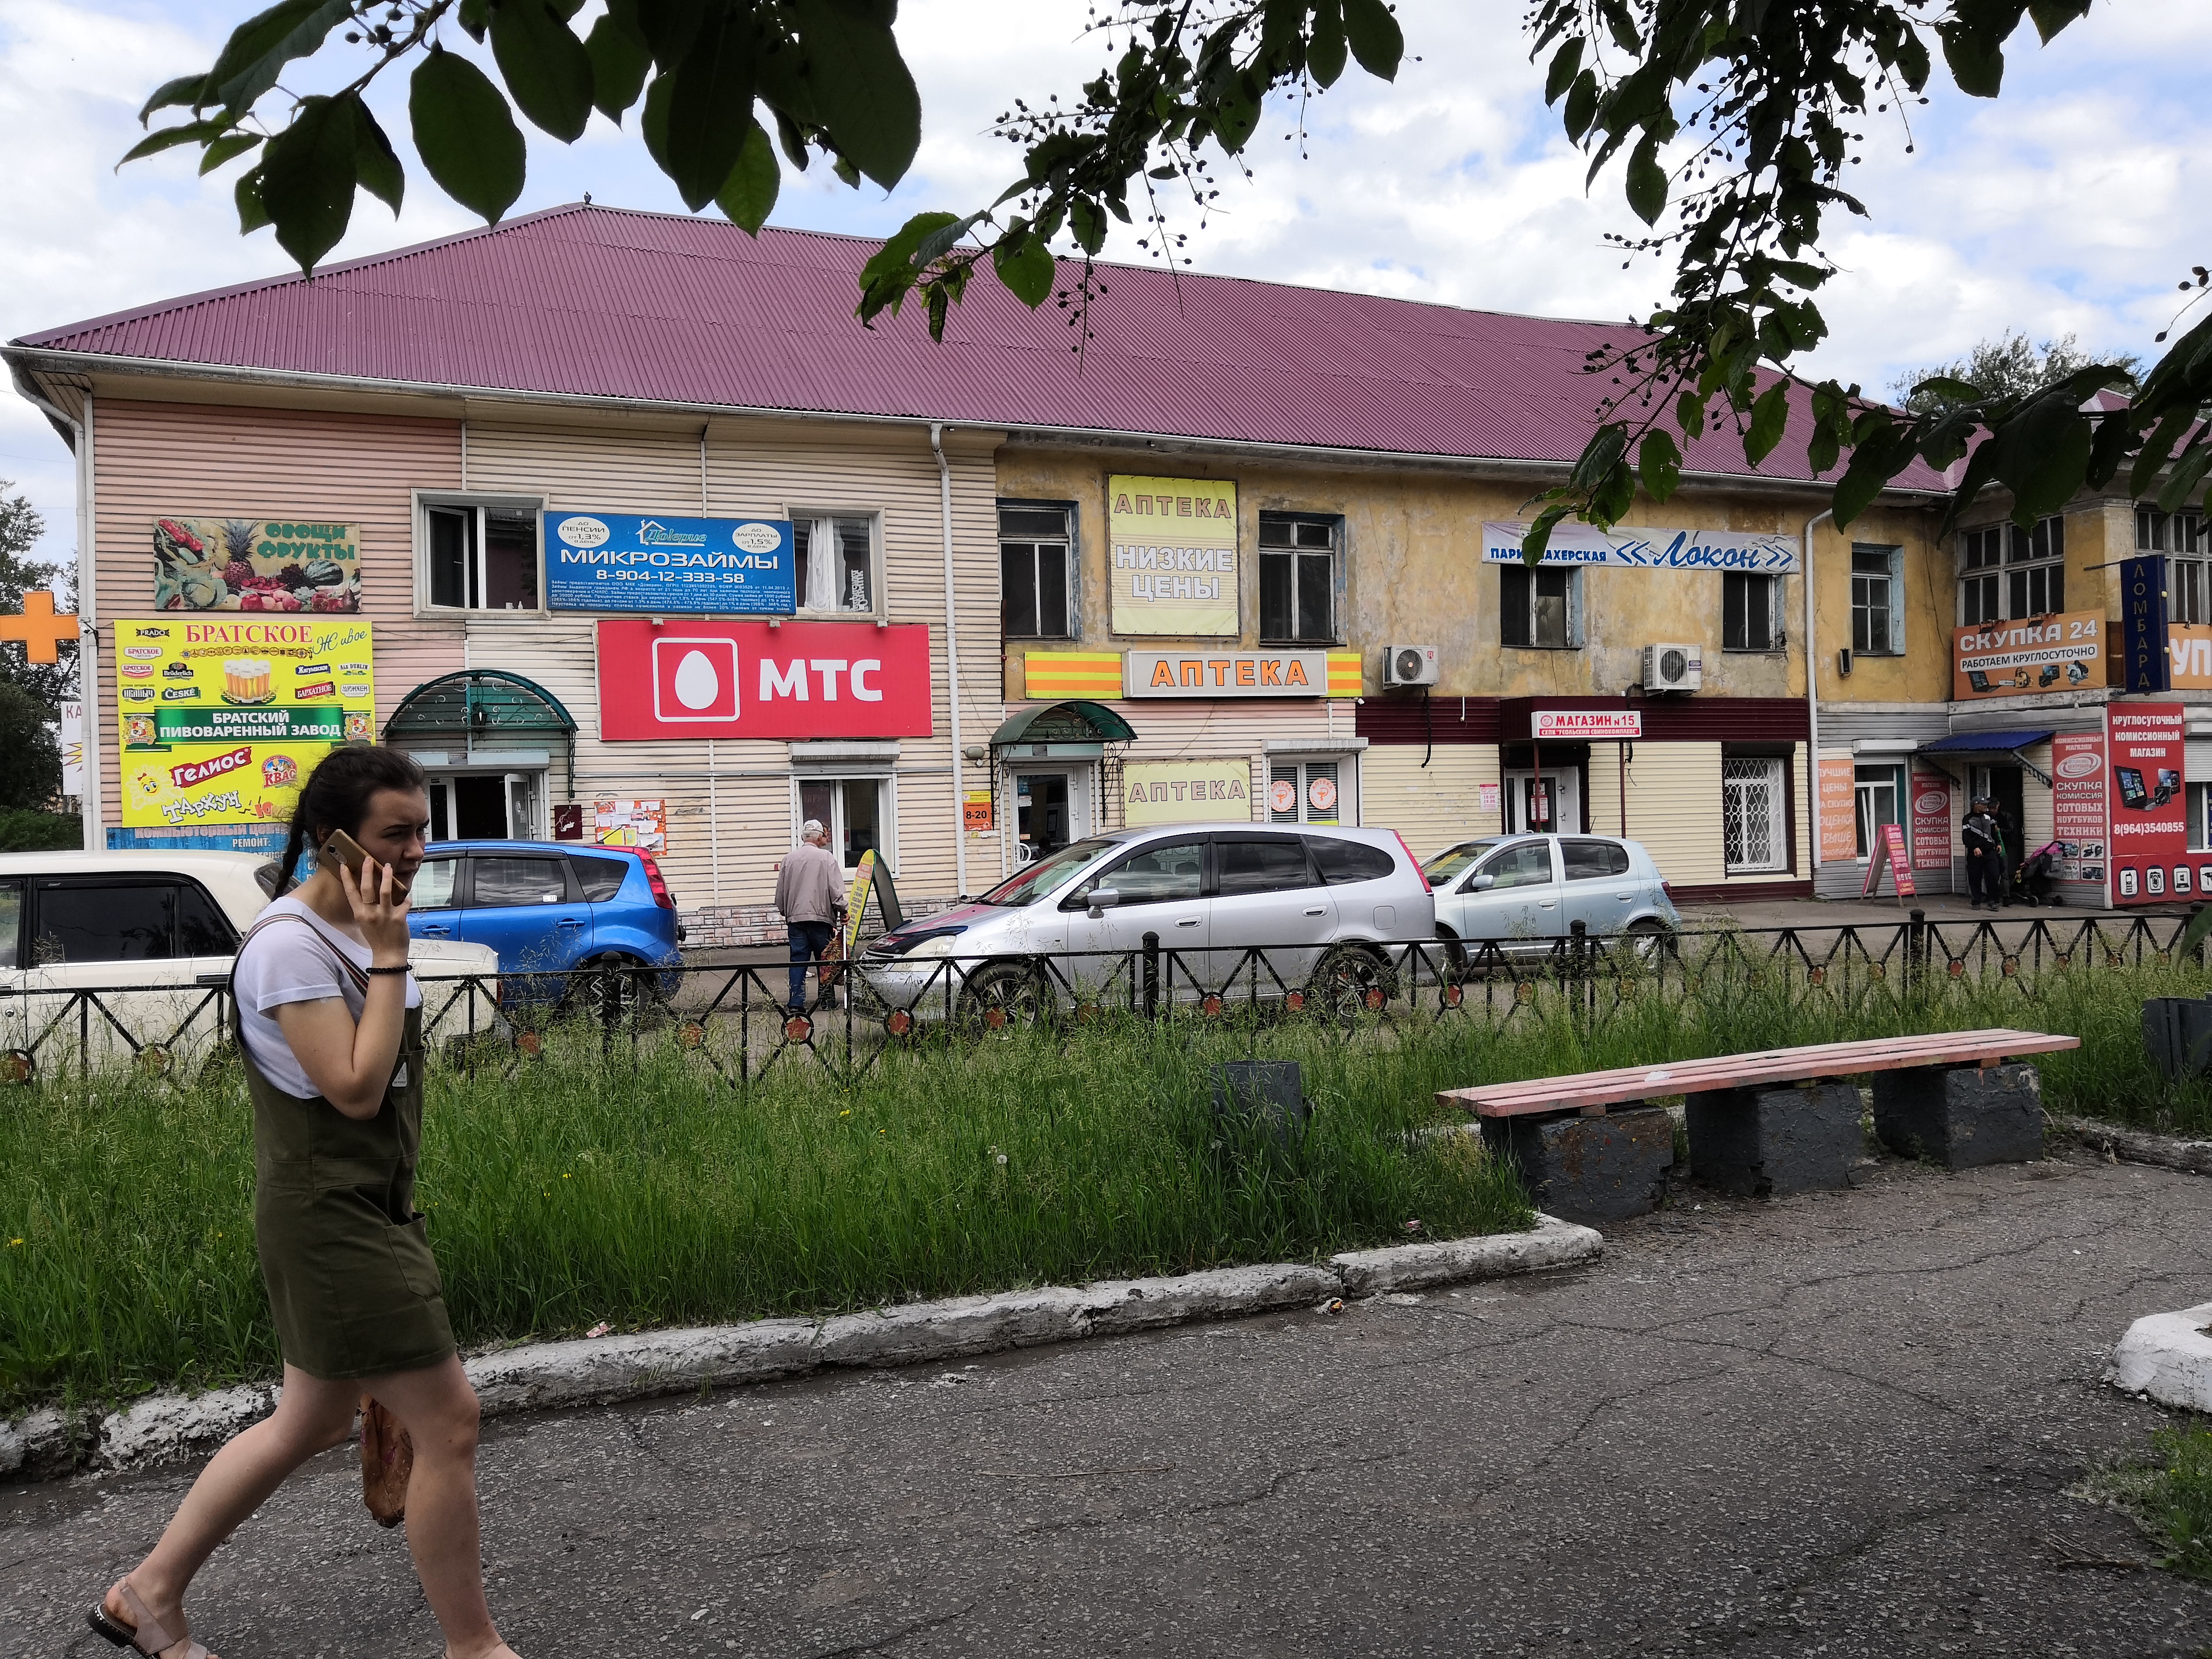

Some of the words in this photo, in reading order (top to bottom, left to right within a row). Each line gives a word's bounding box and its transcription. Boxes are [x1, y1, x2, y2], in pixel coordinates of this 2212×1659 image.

[1114, 493, 1232, 519] АПТЕКА
[257, 541, 355, 560] ФРУКТЫ
[1491, 548, 1607, 562] ПАРИАХЕРСКАЯ
[561, 549, 778, 570] МИКРОЗАЙМЫ
[1116, 545, 1233, 572] НИЗКИЕ
[596, 569, 745, 583] 8-904-12-333-58
[1132, 575, 1219, 602] ЦЕНЫ
[2133, 564, 2150, 688] ЛОМБАРД
[185, 625, 313, 643] БРАТСКОЕ
[1960, 624, 2061, 651] СКУПКА
[2069, 619, 2098, 640] 24
[1962, 655, 2010, 669] РАБОТАЕМ
[2013, 647, 2095, 663] КРУГЛОСУТОЧНО
[758, 659, 883, 702] МТС
[1150, 660, 1309, 687] АПТЕКА
[165, 688, 195, 698] ČESKÉ
[297, 684, 332, 698] БАРХАТНОЕ
[212, 709, 289, 724] БРАТСКИЙ
[1556, 715, 1611, 726] МАГАЗИН
[1622, 715, 1635, 726] 15
[2113, 714, 2182, 727] КРУГЛОСУТОЧНЫЙ
[159, 723, 287, 738] ПИВОВАРЕННЫЙ
[291, 724, 341, 737] ЗАВОД
[2116, 730, 2179, 741] КОМИССИОННЫЙ
[2130, 748, 2166, 757] МАГАЗИН
[264, 769, 296, 788] КВАС
[1312, 780, 1333, 790] АПТЕКА
[1129, 779, 1246, 803] АПТЕКА
[1271, 782, 1291, 792] АПТЕКА
[1823, 783, 1847, 793] ЦЕНЫ
[2056, 781, 2102, 791] СКУПКА
[2057, 803, 2103, 812] СОТОВЫХ
[966, 811, 987, 819] 8-20
[1819, 814, 1853, 830] ОЦЕНКА
[1915, 817, 1948, 825] СКУПКА
[2057, 816, 2103, 824] НОУТБУКОВ
[2057, 827, 2103, 836] ТЕХНИКИ
[2114, 822, 2184, 836] 8(964)3540855
[232, 838, 271, 848] РЕМОНТ:
[1823, 831, 1851, 844] ВЫШЕ
[1915, 837, 1949, 846] СОТОВЫХ
[1916, 848, 1949, 856] НОУТБУКОВ
[1916, 858, 1949, 868] ТЕХНИКИ
